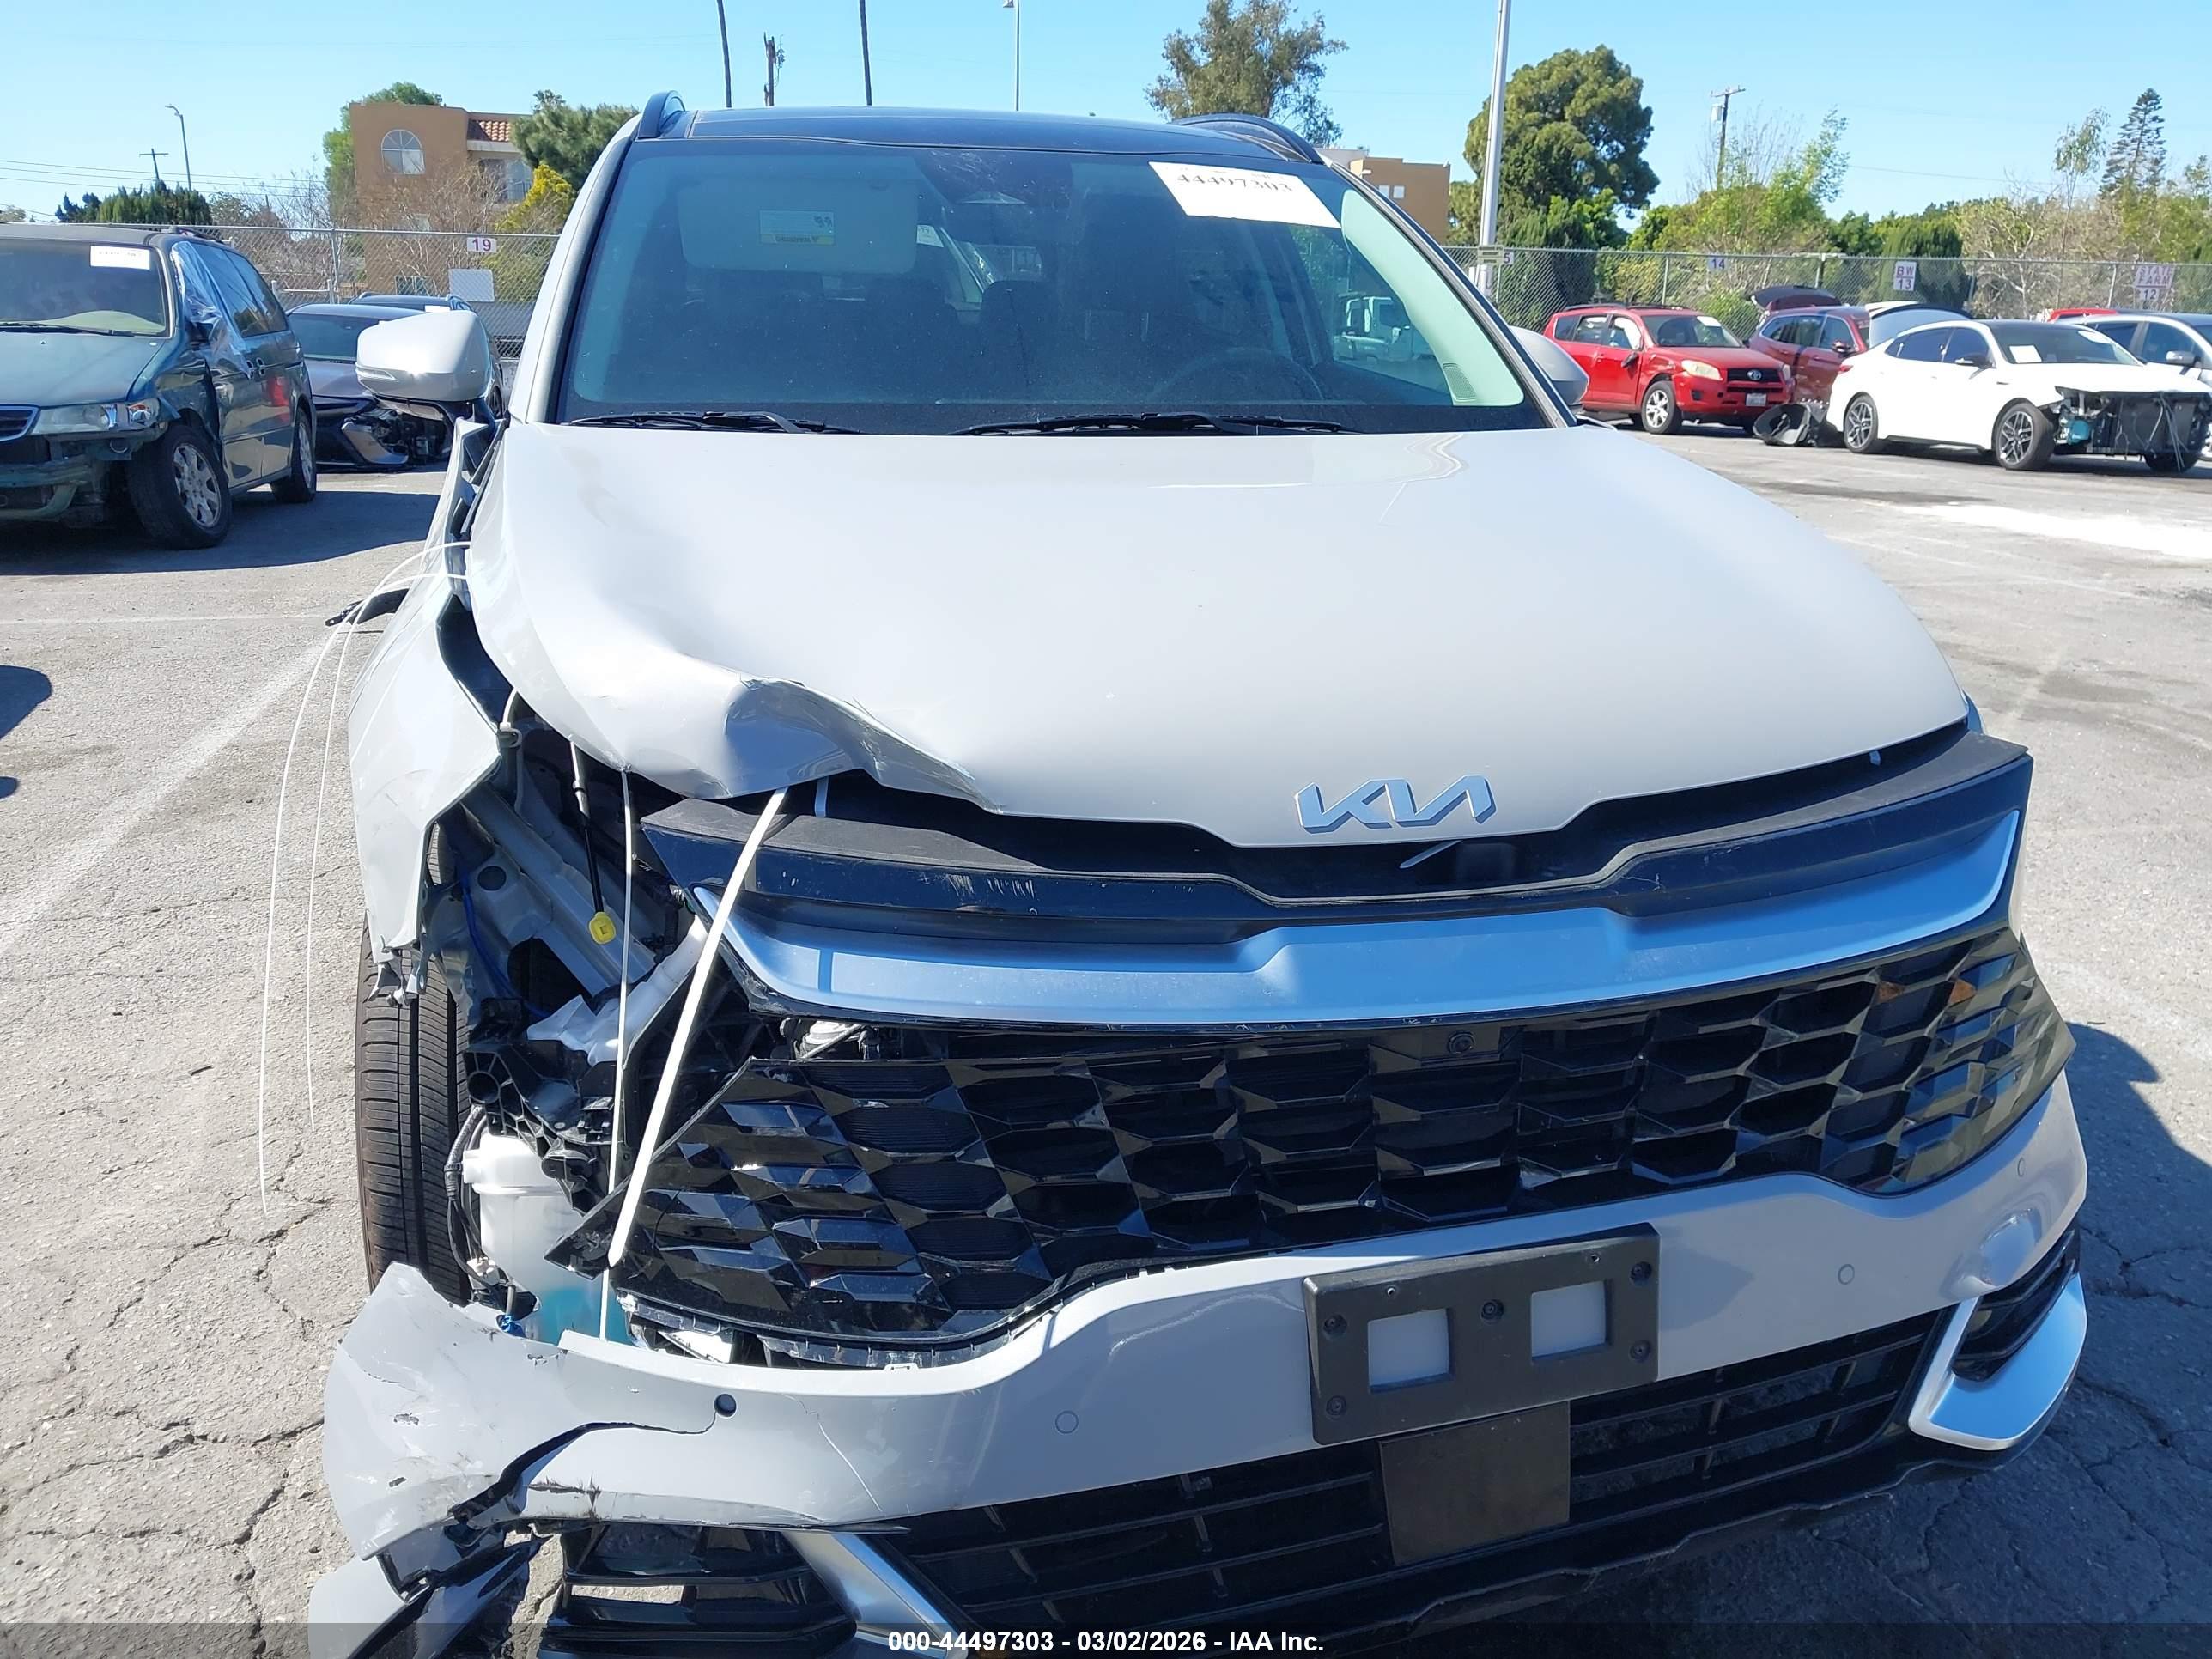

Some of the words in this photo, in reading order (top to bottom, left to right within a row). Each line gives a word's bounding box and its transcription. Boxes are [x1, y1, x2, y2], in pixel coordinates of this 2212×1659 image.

[471, 239, 492, 252] 19
[1711, 258, 1725, 269] 14
[2140, 265, 2172, 275] STATE
[1898, 279, 1911, 289] 13
[2138, 275, 2170, 284] FARM
[2143, 289, 2157, 300] 12
